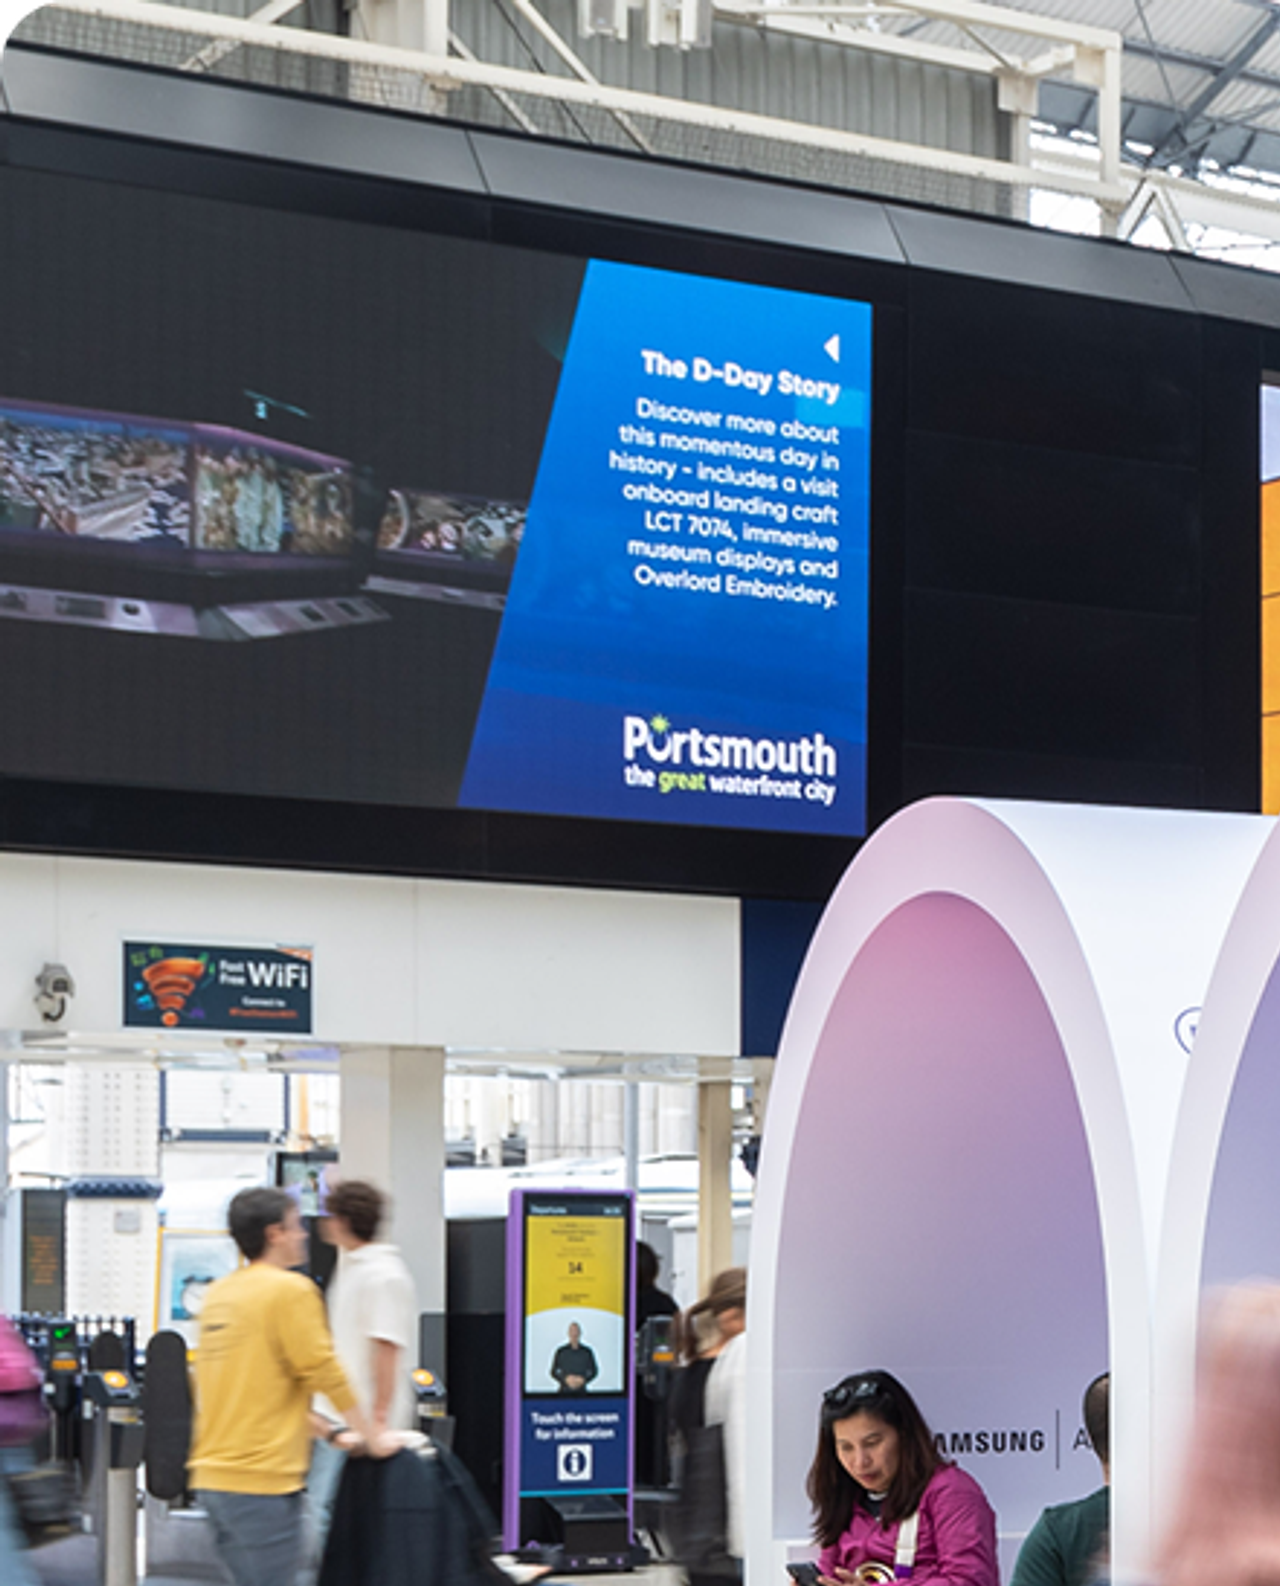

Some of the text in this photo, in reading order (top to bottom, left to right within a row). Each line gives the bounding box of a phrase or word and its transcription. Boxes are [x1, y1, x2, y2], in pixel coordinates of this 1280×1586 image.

[641, 348, 840, 406] The D-Day Story
[636, 397, 839, 444] Discover more about
[618, 424, 839, 472] this momentous day in
[609, 450, 677, 480] history
[698, 462, 778, 492] includes
[782, 477, 796, 492] a
[801, 476, 838, 498] visit
[623, 482, 838, 526] onboard landing craft
[644, 510, 838, 552] LCT 7074, immersive
[628, 540, 838, 579] museum displays and
[634, 564, 838, 610] Overlord Embroidery.
[623, 714, 837, 777] Portsmouth
[624, 764, 836, 806] the great waterfront city
[247, 961, 308, 989] WiFi
[531, 1412, 620, 1424] Touch the screen
[536, 1427, 615, 1440] for information
[934, 1429, 1044, 1454] AMSUNG
